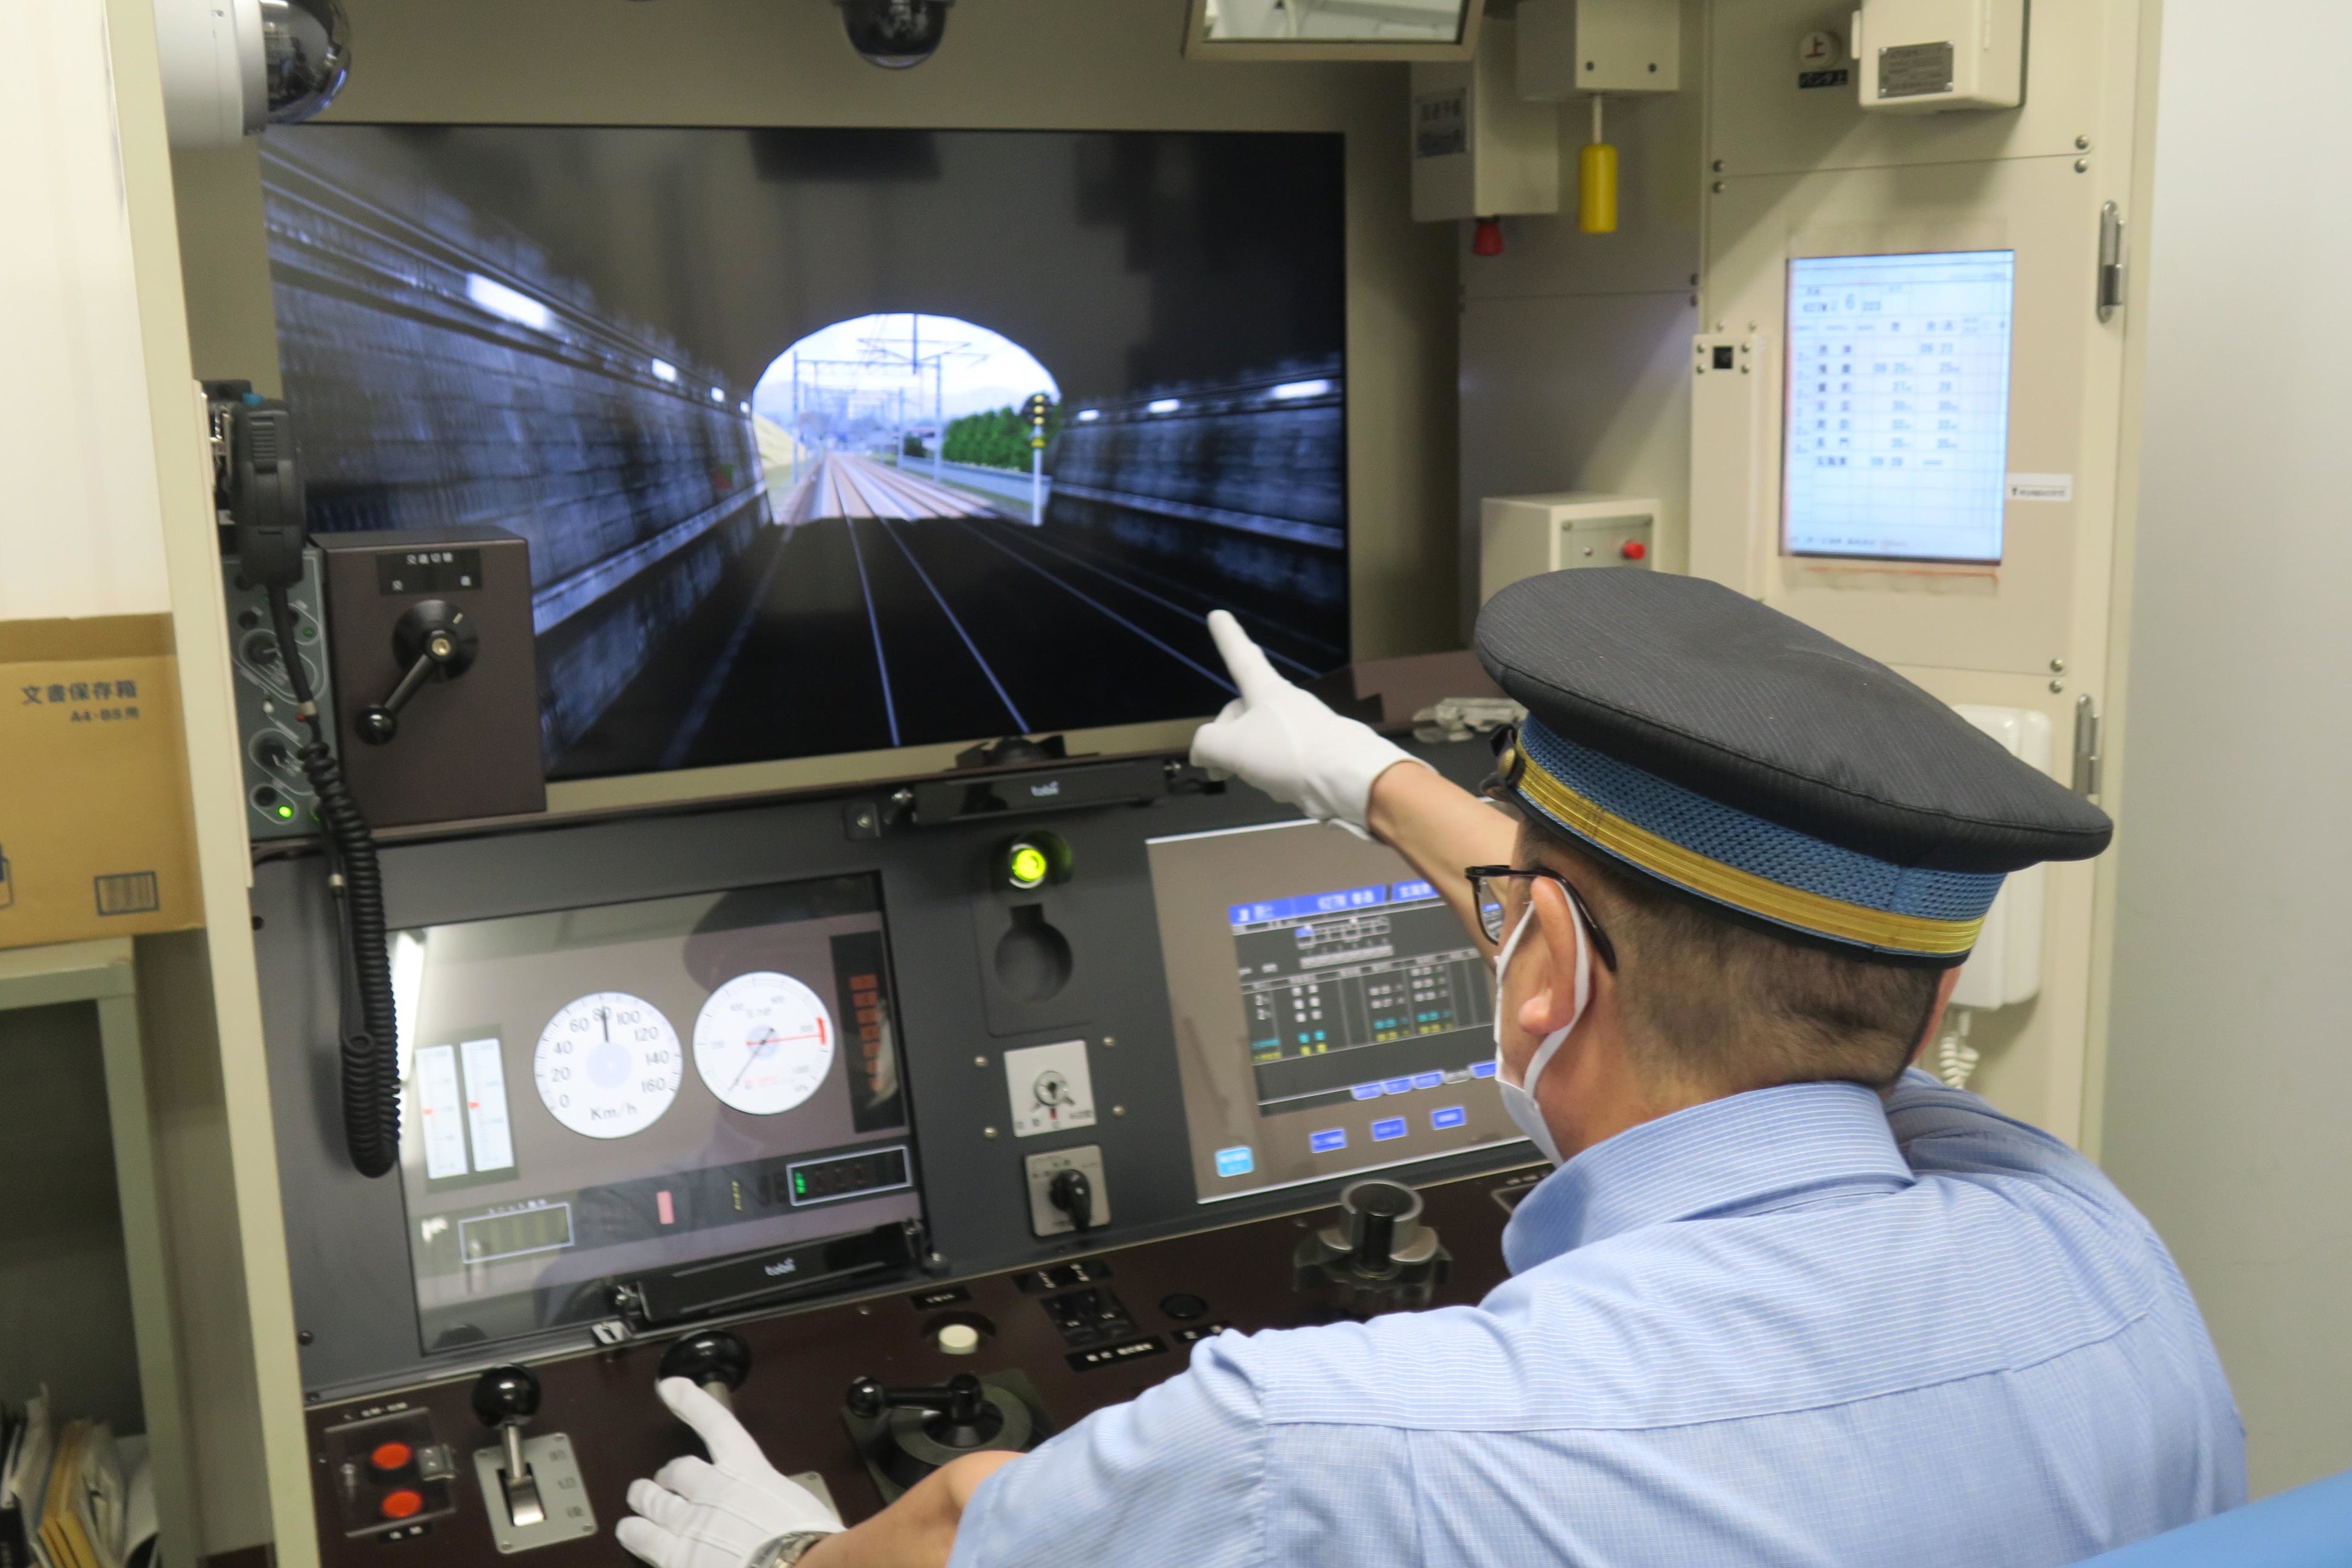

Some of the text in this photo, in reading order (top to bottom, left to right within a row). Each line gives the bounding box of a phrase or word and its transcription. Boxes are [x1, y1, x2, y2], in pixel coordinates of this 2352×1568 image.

[1805, 36, 1825, 59] 上
[21, 680, 136, 705] 文書保存箱
[569, 1017, 589, 1033] 60
[617, 1010, 641, 1025] 100
[634, 1026, 659, 1042] 120
[554, 1040, 573, 1055] 40
[645, 1050, 669, 1065] 140
[551, 1066, 571, 1082] 20
[641, 1078, 665, 1093] 160
[558, 1093, 570, 1108] 0
[590, 1102, 637, 1121] Km/h
